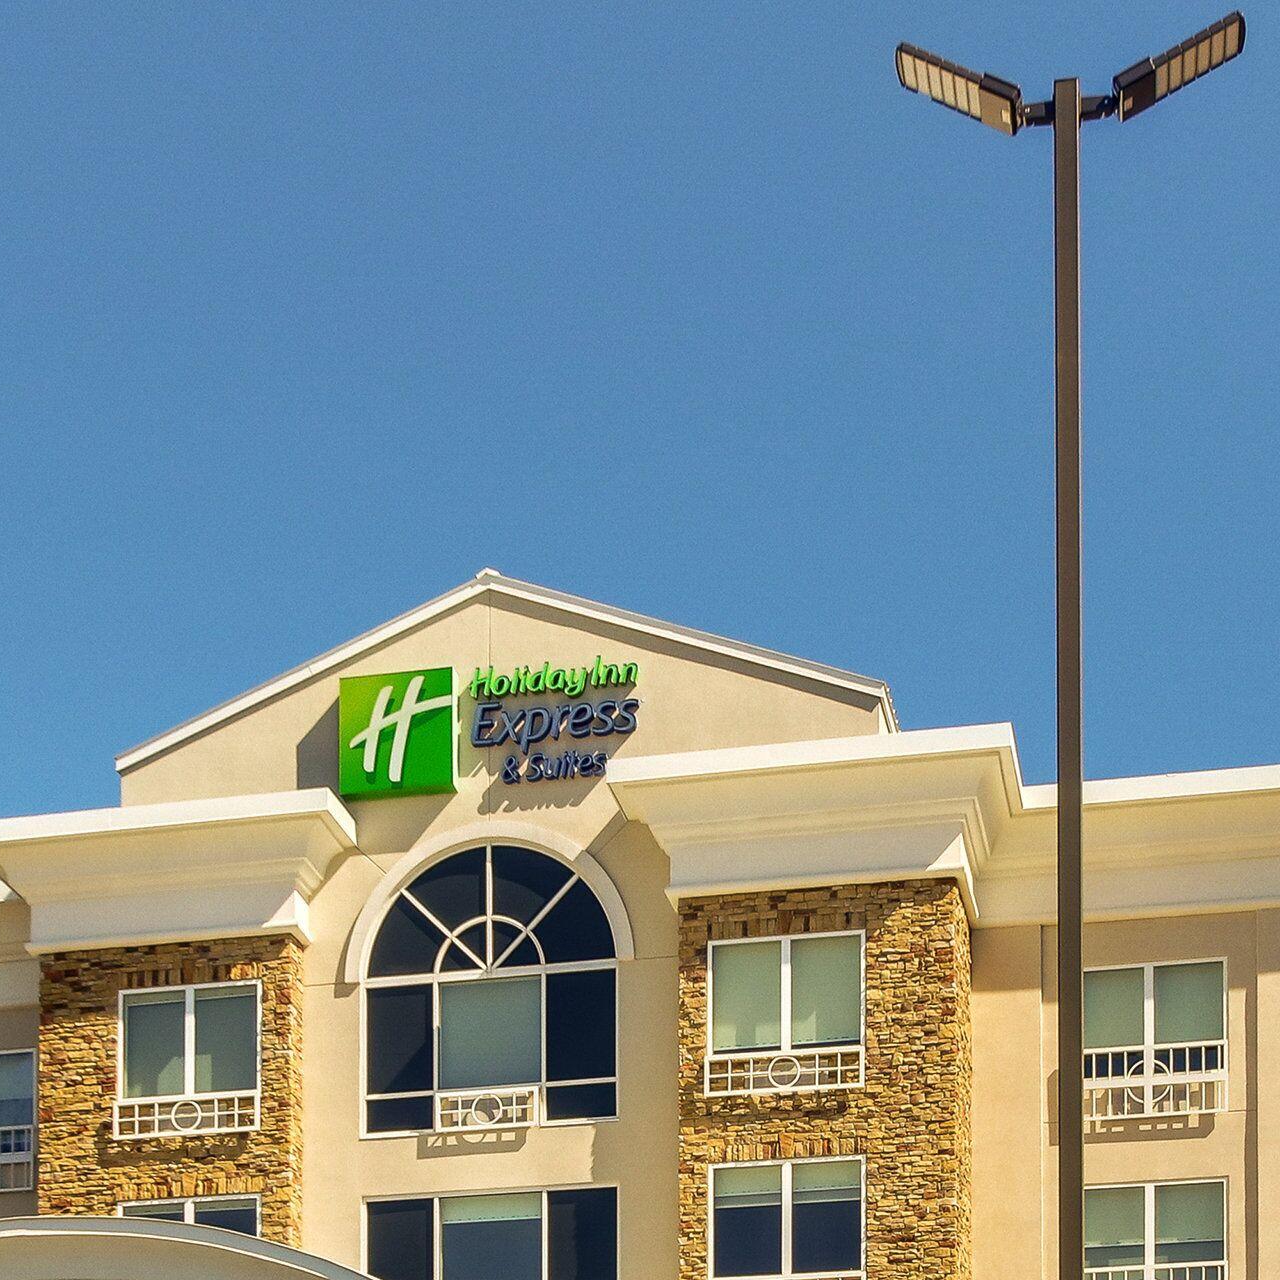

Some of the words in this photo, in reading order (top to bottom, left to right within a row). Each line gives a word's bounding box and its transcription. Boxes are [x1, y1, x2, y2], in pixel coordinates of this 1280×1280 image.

[470, 661, 588, 700] Holiday
[591, 654, 639, 689] Inn
[471, 698, 640, 756] Express
[501, 755, 520, 785] &
[526, 751, 609, 782] Suites
